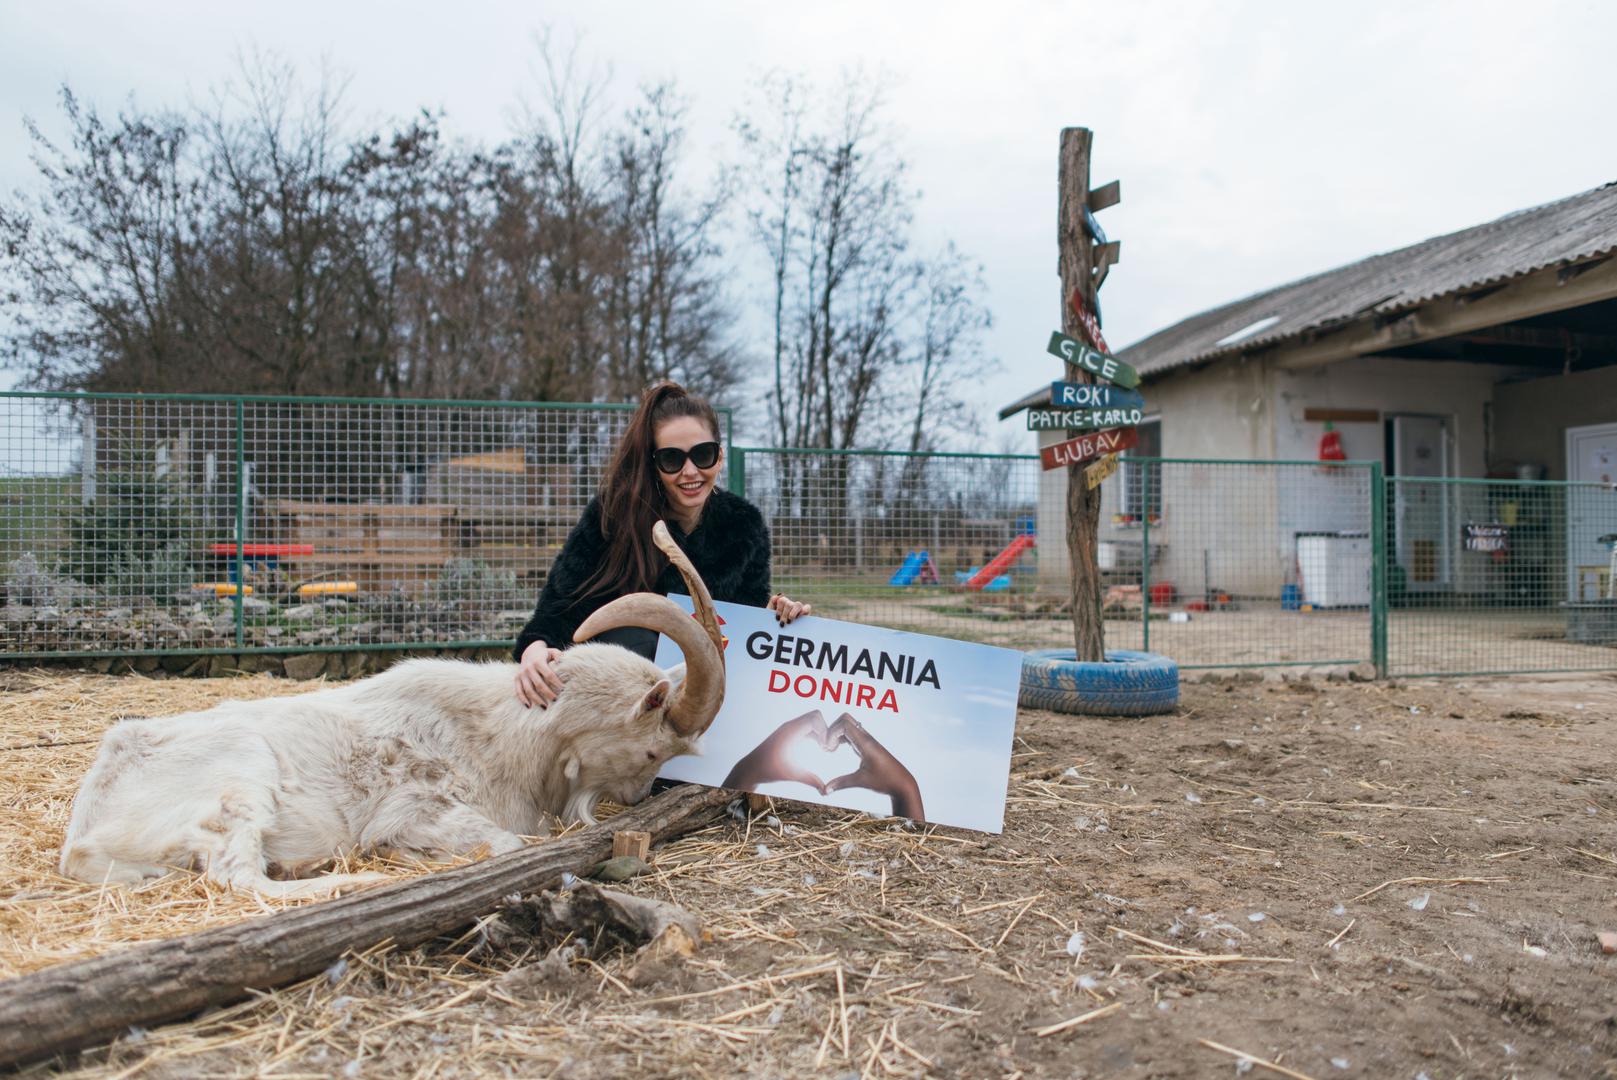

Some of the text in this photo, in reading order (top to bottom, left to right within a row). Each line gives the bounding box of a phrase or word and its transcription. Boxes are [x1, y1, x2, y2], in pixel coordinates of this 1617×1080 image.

[1060, 340, 1119, 379] GICE
[1063, 386, 1109, 406] ROKI
[1029, 409, 1141, 430] PATKE-KARLO
[1053, 432, 1121, 465] LJUBAV
[746, 631, 941, 689] GERMANIA
[768, 670, 899, 713] DONIRA
